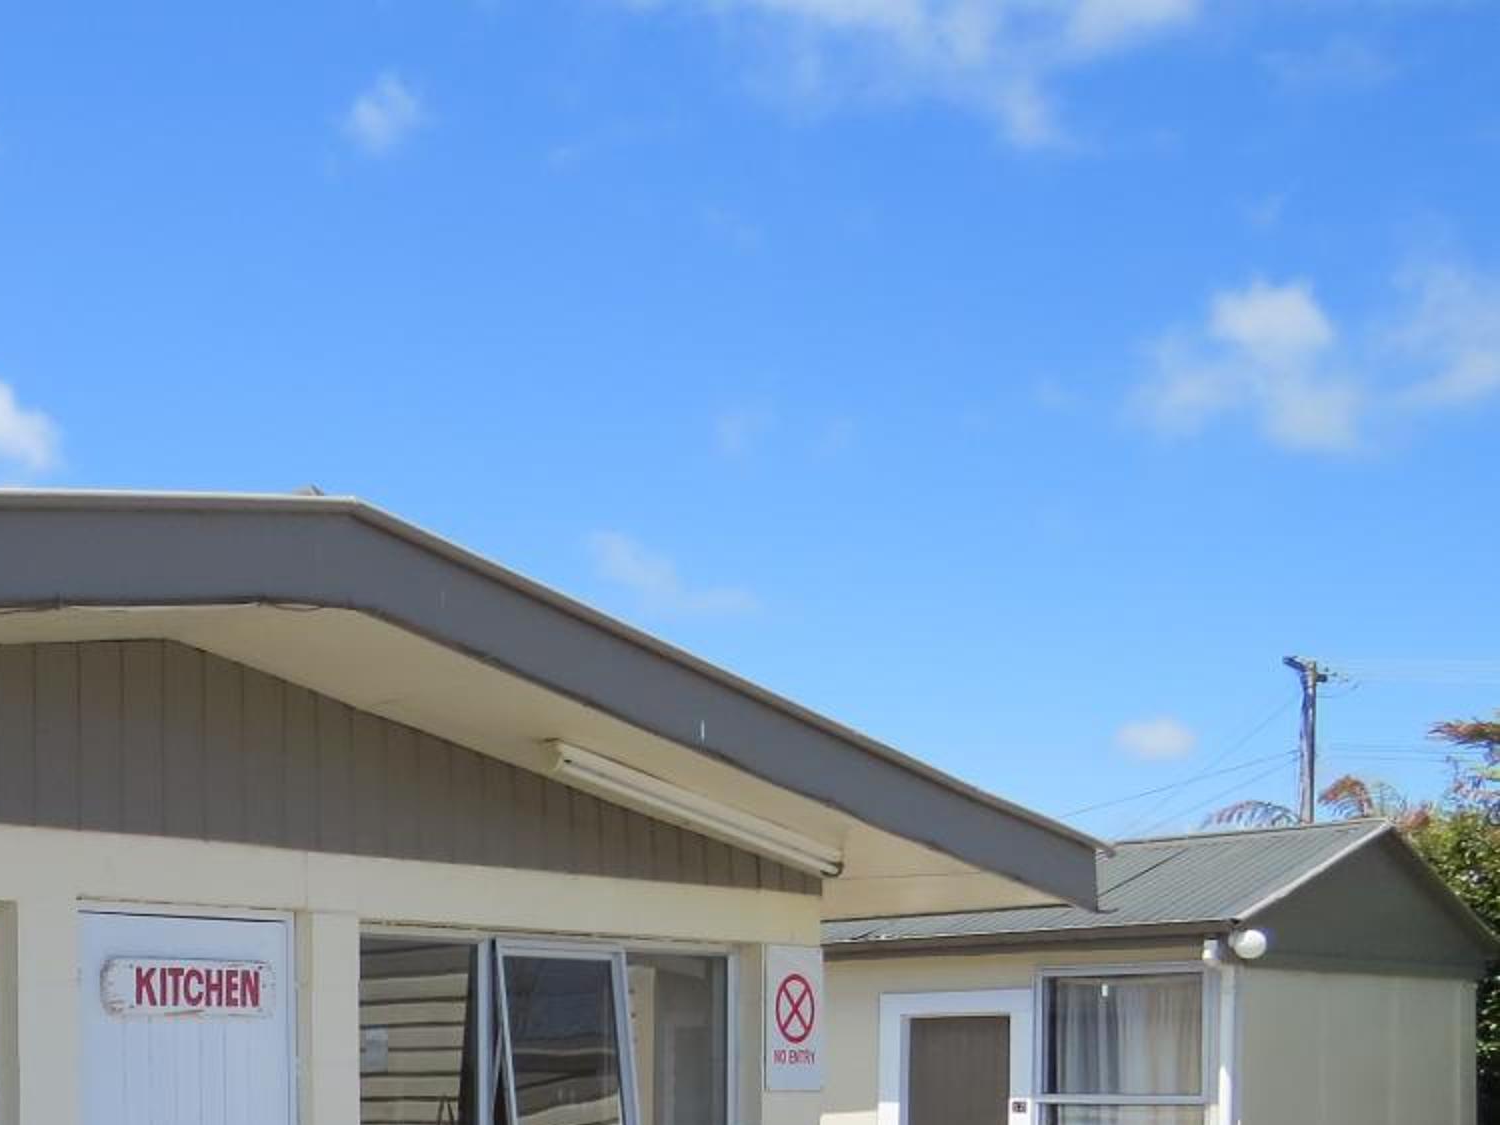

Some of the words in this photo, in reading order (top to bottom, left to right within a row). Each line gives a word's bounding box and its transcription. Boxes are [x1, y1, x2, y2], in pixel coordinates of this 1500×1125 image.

[135, 967, 260, 1008] KITCHEN
[773, 1049, 787, 1064] NO
[789, 1049, 816, 1064] ENTRY
